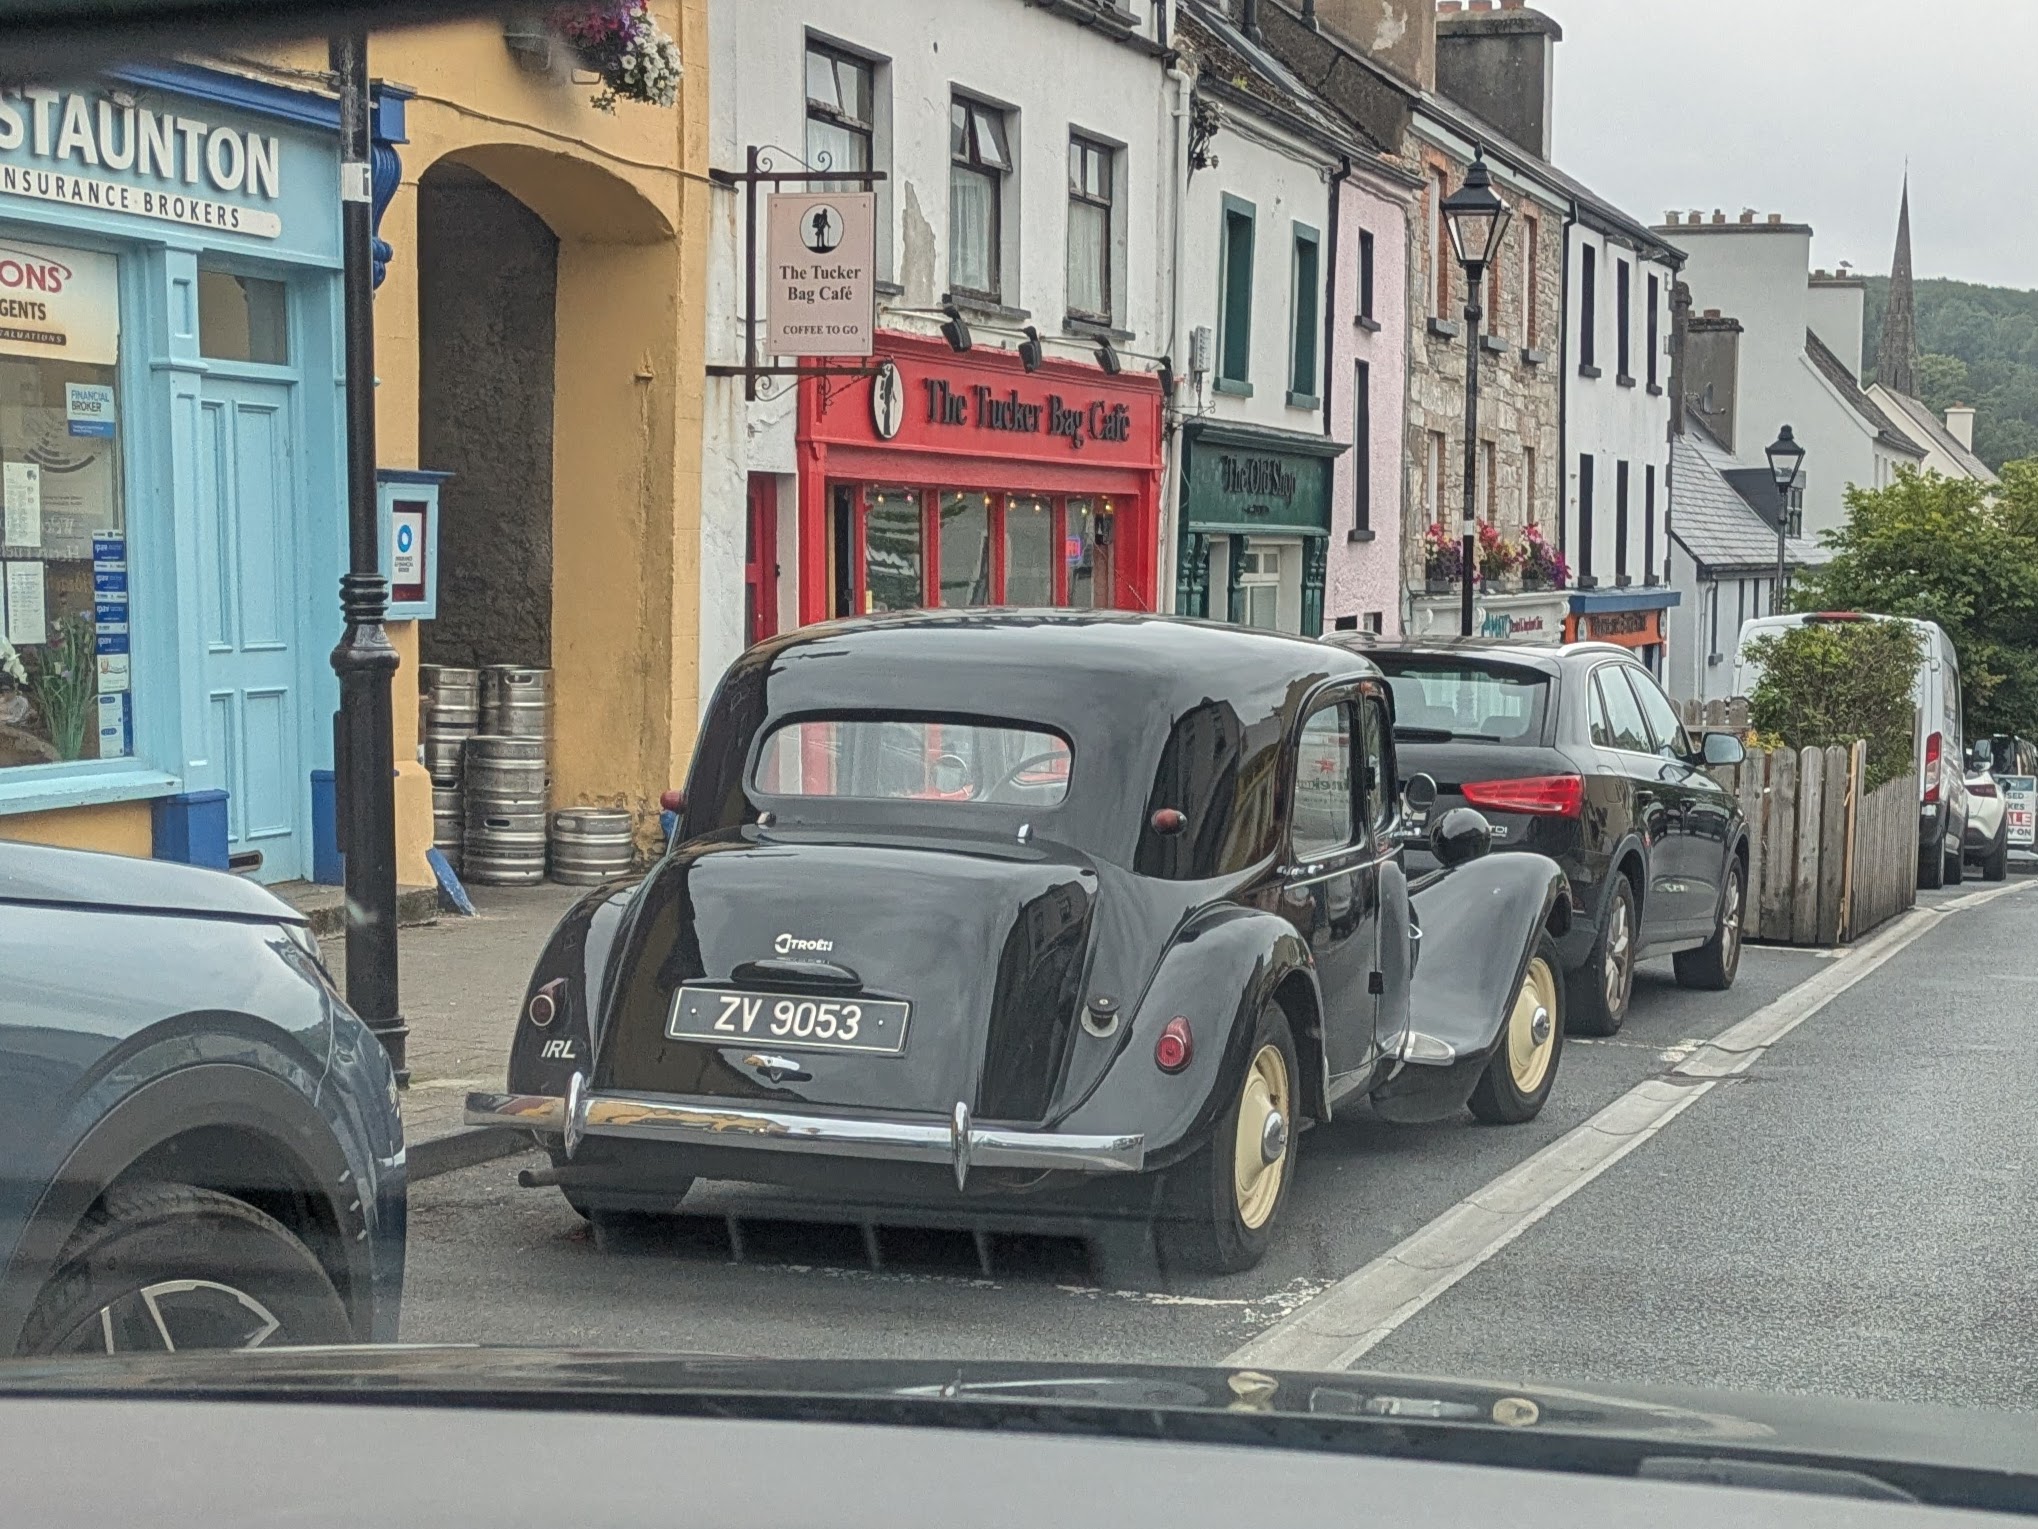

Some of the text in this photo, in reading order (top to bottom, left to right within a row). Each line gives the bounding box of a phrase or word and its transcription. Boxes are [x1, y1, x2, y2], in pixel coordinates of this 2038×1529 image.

[4, 167, 240, 228] NSURANCE BROKERS
[0, 260, 62, 293] ONS
[779, 264, 861, 280] The Tucker
[788, 285, 852, 304] Bag Café
[0, 298, 46, 321] GENTS
[783, 325, 858, 335] COFFEE TO GO
[922, 377, 1130, 449] The Tucker Bag Café
[1220, 455, 1248, 493] The
[2008, 792, 2024, 800] SED
[2008, 803, 2025, 811] KES
[2017, 828, 2031, 837] ON
[713, 996, 862, 1041] ZV 9053
[541, 1039, 576, 1059] IRL
